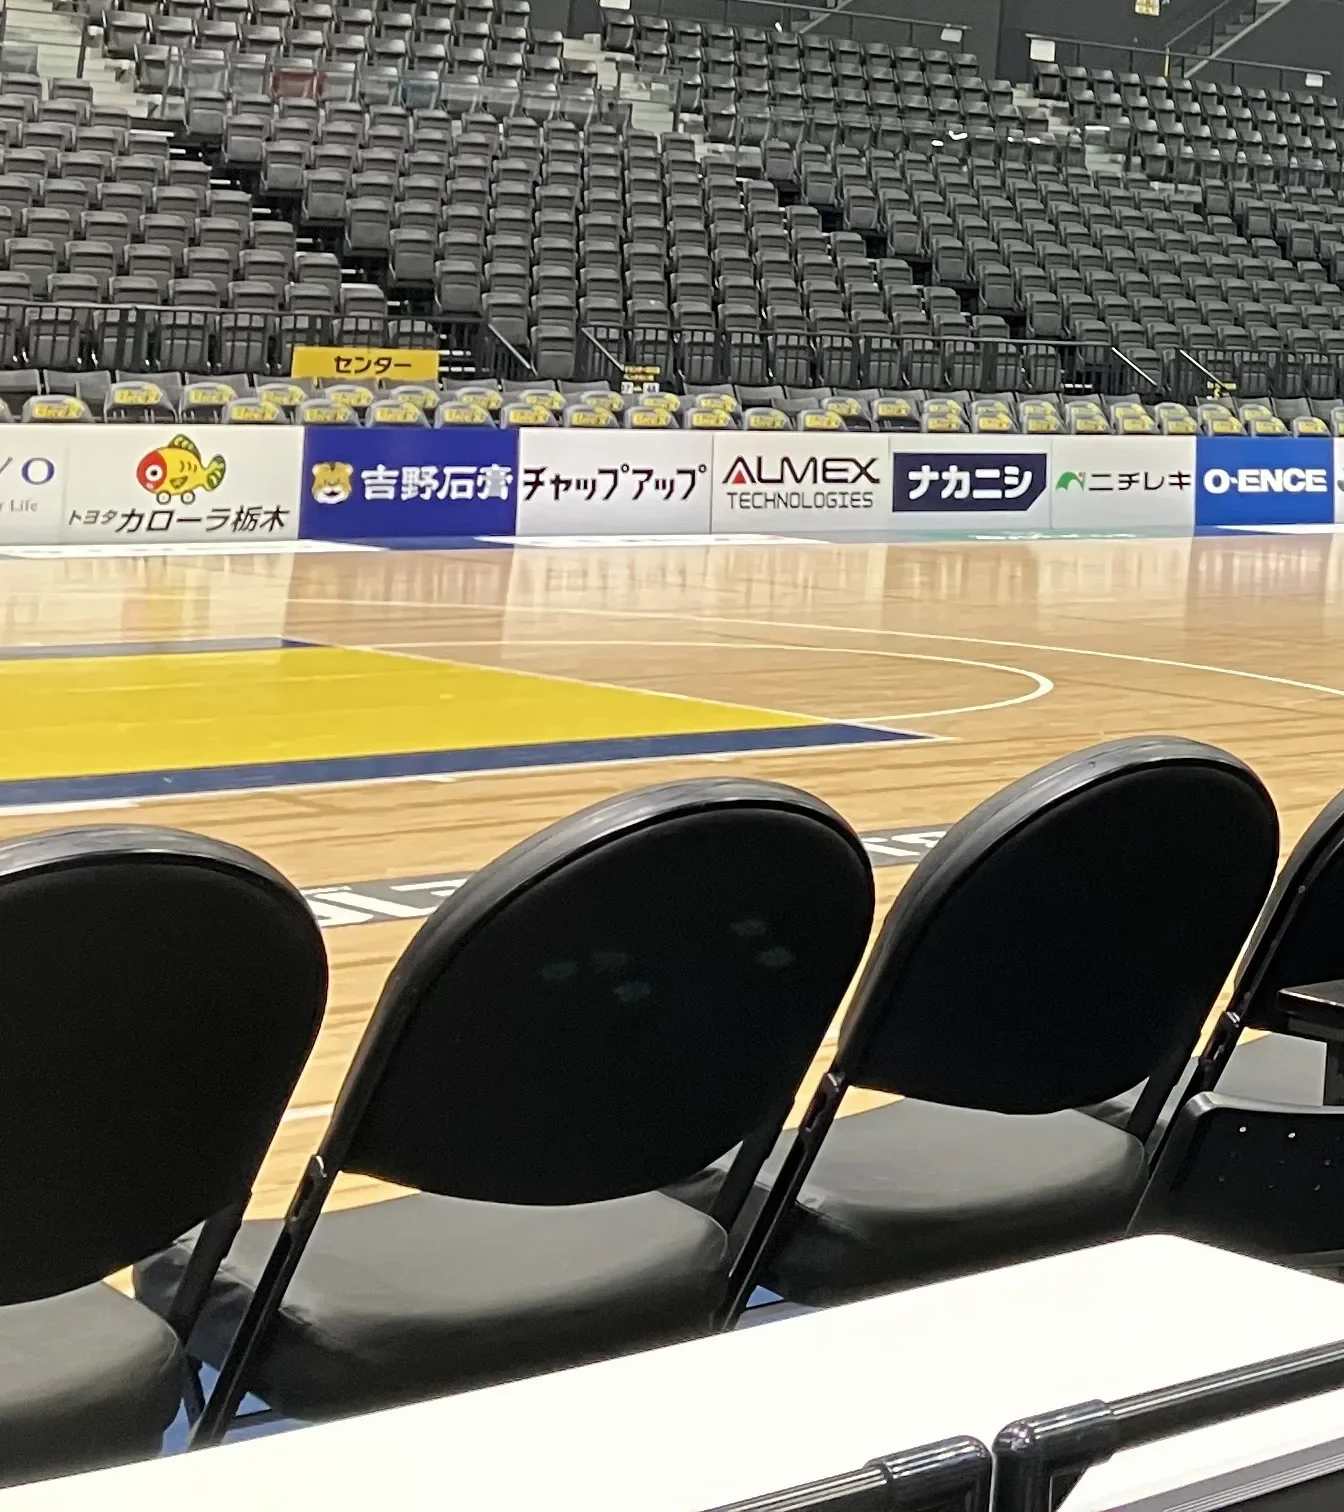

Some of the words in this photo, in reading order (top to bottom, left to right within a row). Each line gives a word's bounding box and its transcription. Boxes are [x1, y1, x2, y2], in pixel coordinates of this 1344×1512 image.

[334, 355, 412, 374] センター
[361, 463, 513, 501] 吉野石膏
[522, 463, 707, 502] チャップアップ
[721, 455, 880, 485] ALMEX
[908, 464, 1033, 500] ナカニシ
[1088, 469, 1192, 492] ニチレキ
[1203, 468, 1328, 494] O-ENCE
[727, 492, 874, 510] TECHNOLOGIES
